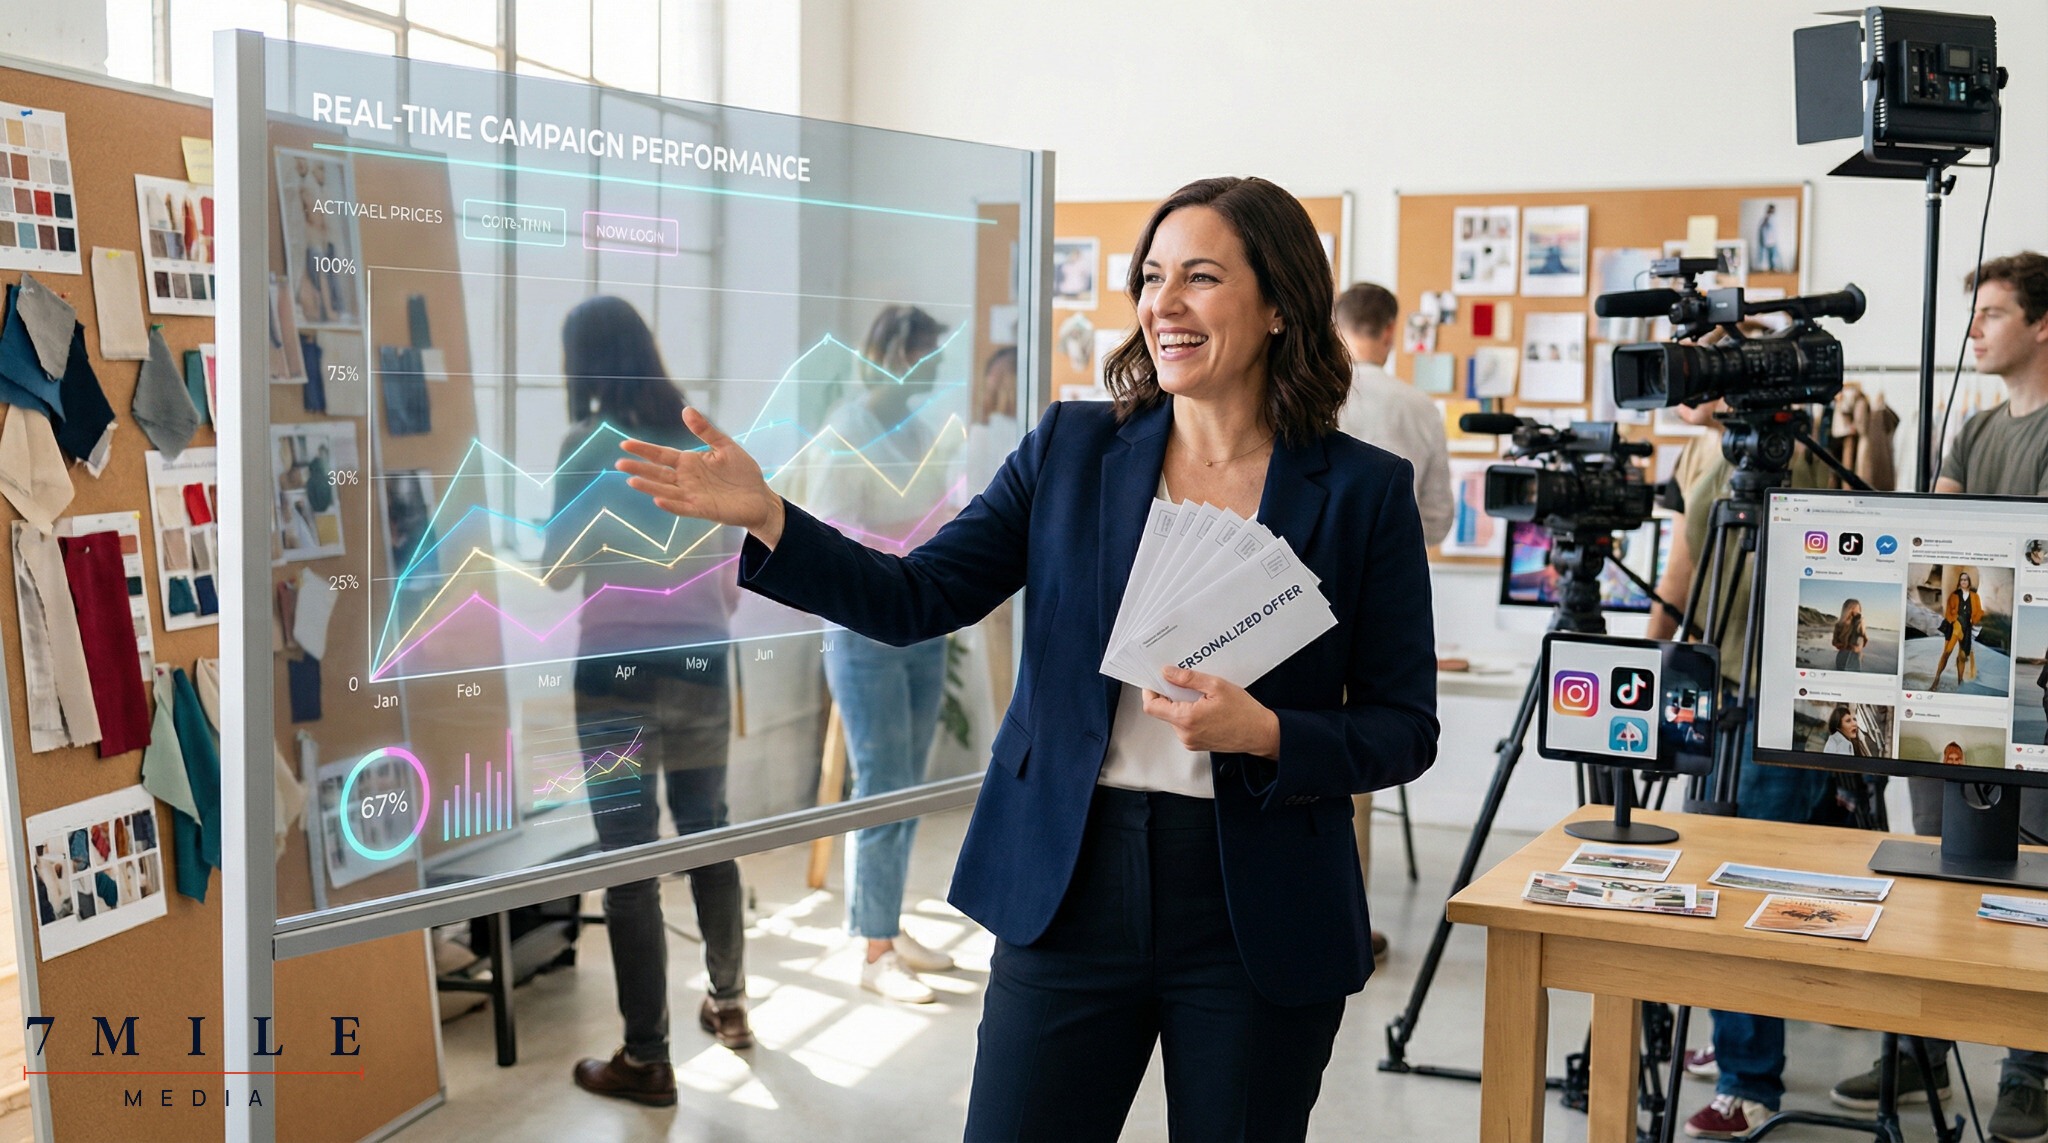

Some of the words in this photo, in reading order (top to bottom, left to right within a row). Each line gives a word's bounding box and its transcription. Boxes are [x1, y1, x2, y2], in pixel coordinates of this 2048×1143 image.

[313, 92, 472, 140] REAL-TIME
[480, 115, 624, 159] CAMPAIGN
[632, 135, 811, 182] PERFORMANCE
[312, 199, 387, 219] ACTIVAEL
[390, 205, 443, 224] PRICES
[597, 224, 628, 240] NOW
[630, 228, 664, 243] LOGIN
[313, 257, 356, 274] 100%
[327, 365, 359, 381] 75%
[327, 470, 358, 486] 30%
[329, 574, 359, 591] 25%
[1177, 611, 1262, 670] ERSONALIZED
[1262, 584, 1304, 616] OFFER
[348, 677, 359, 691] 0
[374, 694, 398, 709] Jan
[457, 684, 481, 698] Feb
[538, 674, 562, 688] Mar
[615, 664, 637, 680] Apr
[686, 657, 709, 671] May
[755, 648, 773, 661] Jun
[819, 640, 834, 652] Jul
[361, 790, 408, 819] 67%
